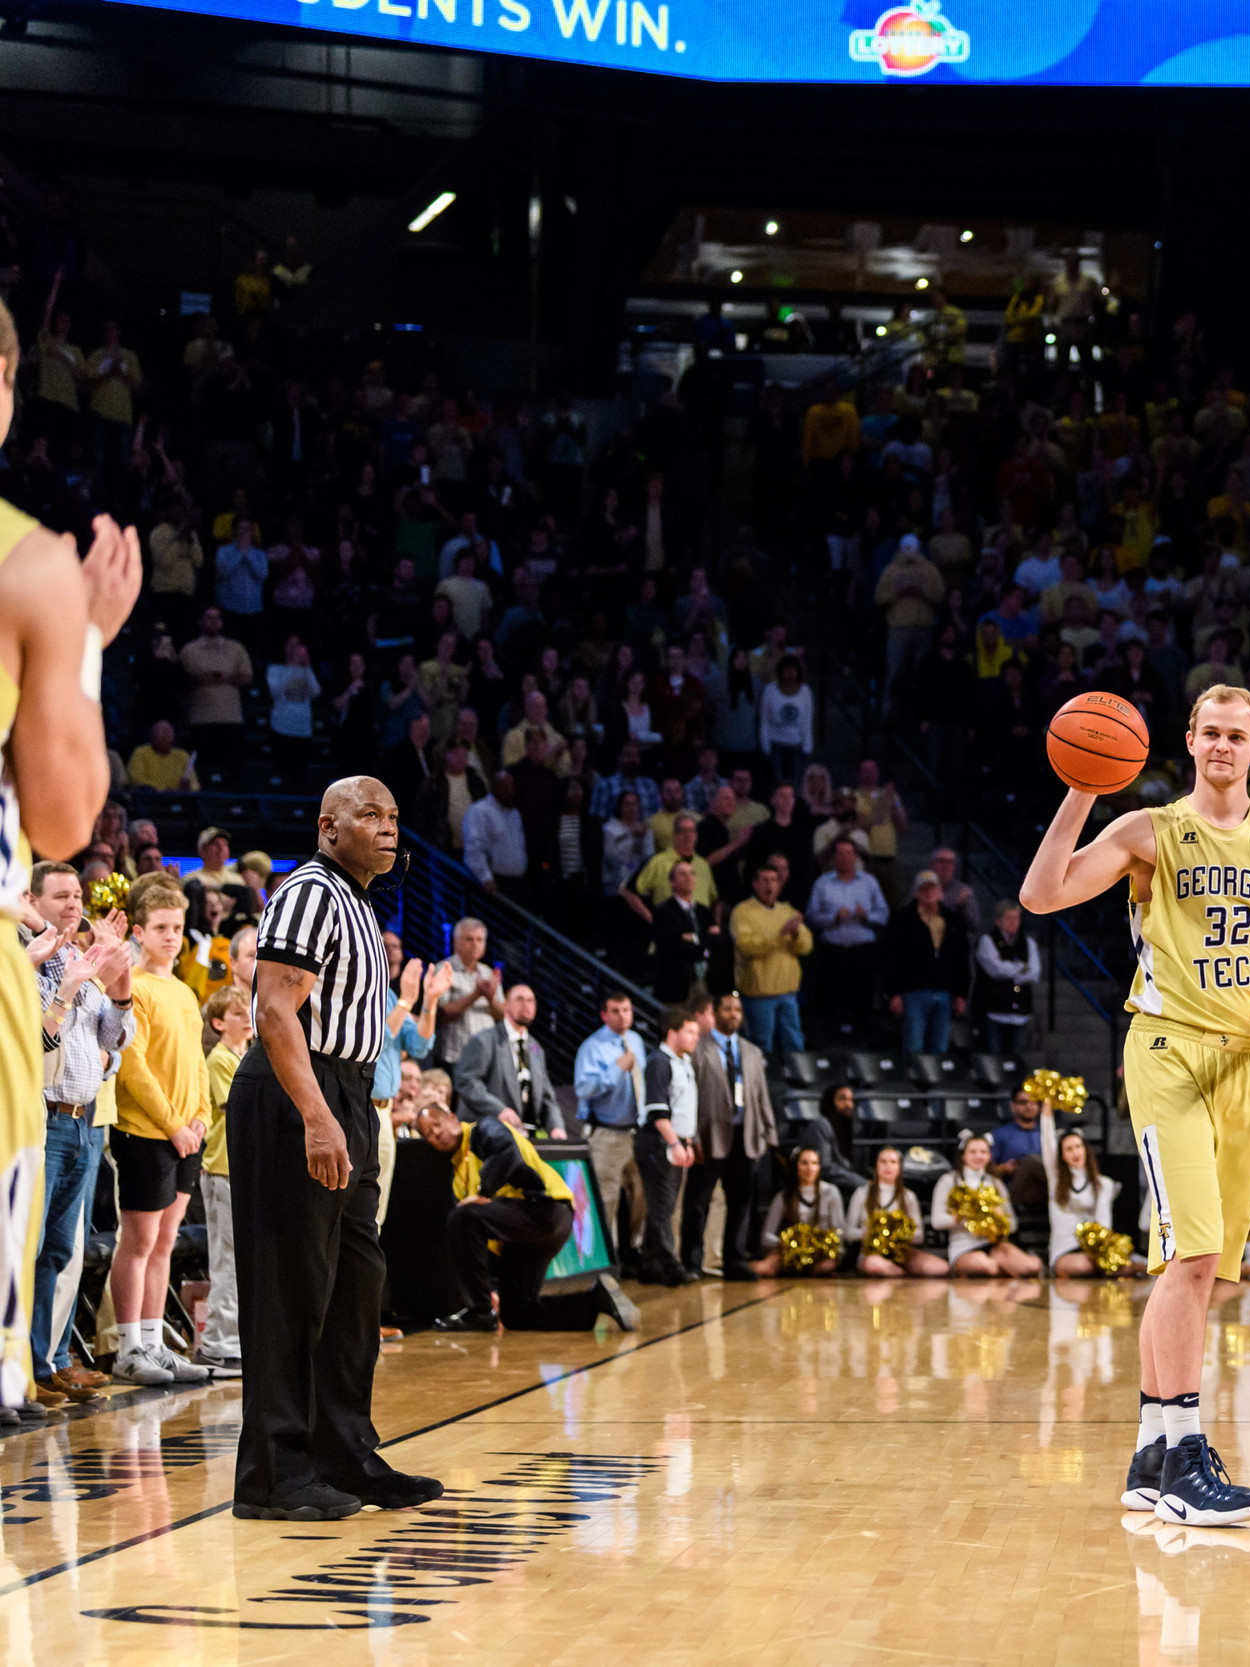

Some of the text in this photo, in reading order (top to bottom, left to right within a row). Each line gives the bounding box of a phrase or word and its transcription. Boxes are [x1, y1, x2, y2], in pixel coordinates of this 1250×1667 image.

[553, 0, 687, 54] WIN.
[79, 1451, 672, 1630] Cremins Court
